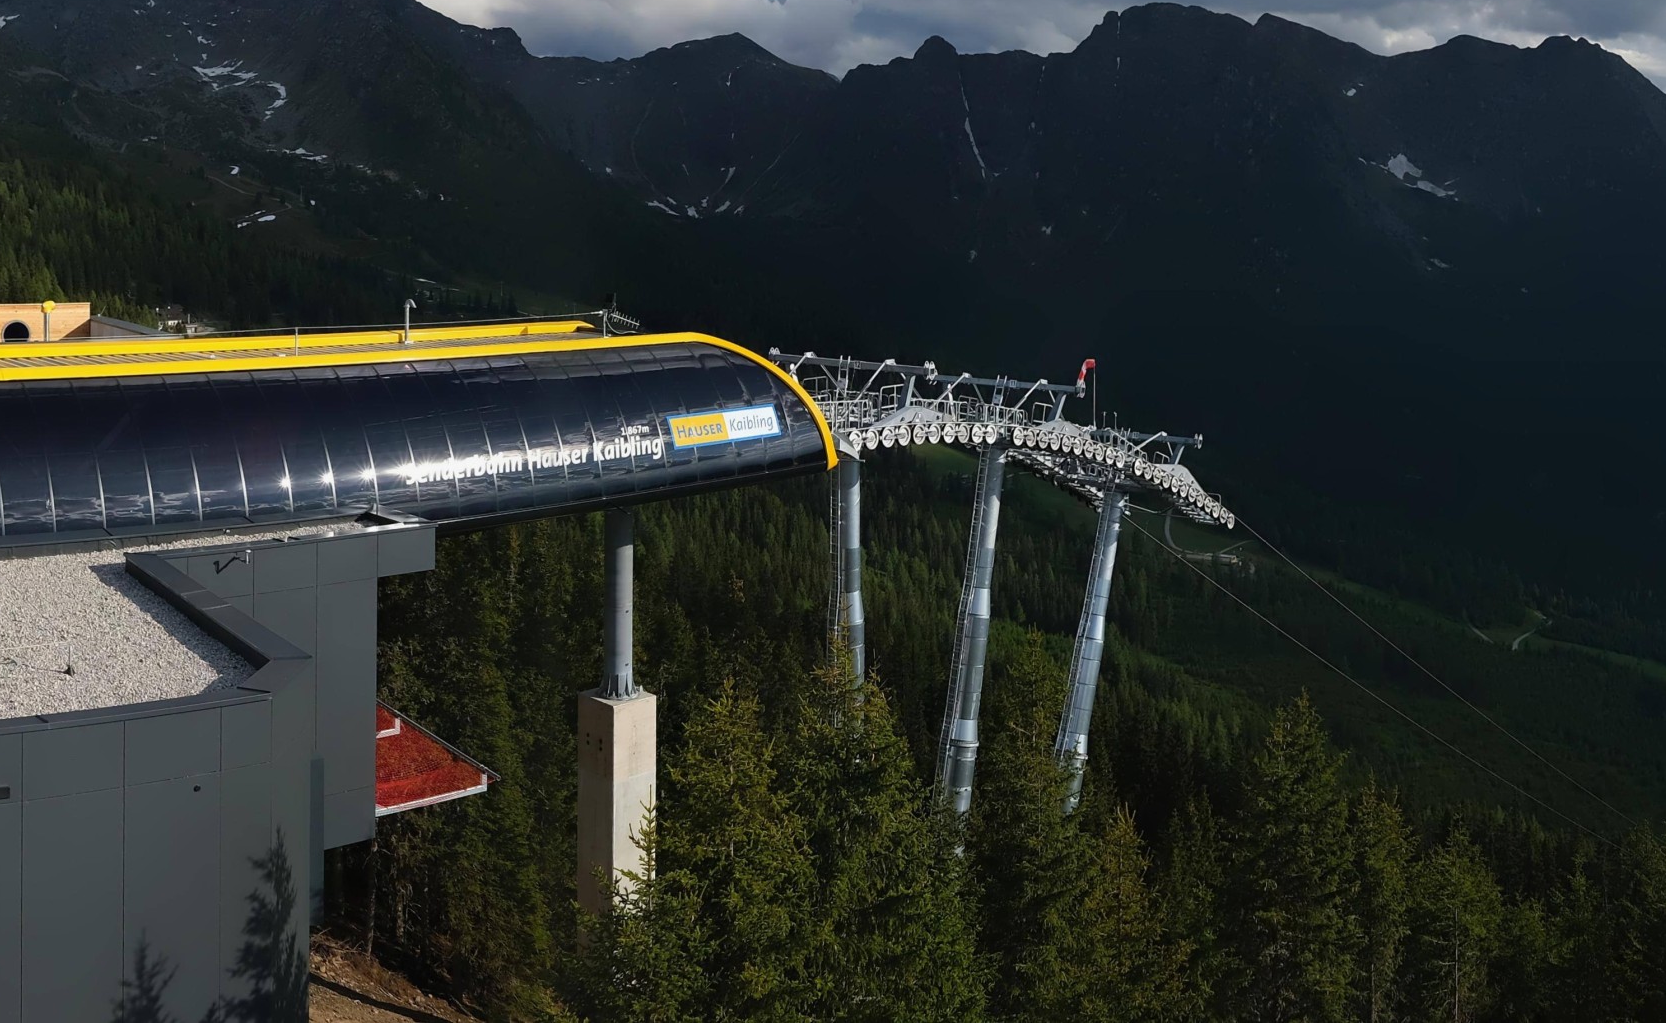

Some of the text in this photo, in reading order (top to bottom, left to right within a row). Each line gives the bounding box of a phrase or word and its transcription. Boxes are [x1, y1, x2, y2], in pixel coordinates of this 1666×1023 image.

[677, 416, 773, 438] HAUSER Kaibling
[527, 446, 589, 471] Hauser
[593, 436, 663, 462] Kaibling
